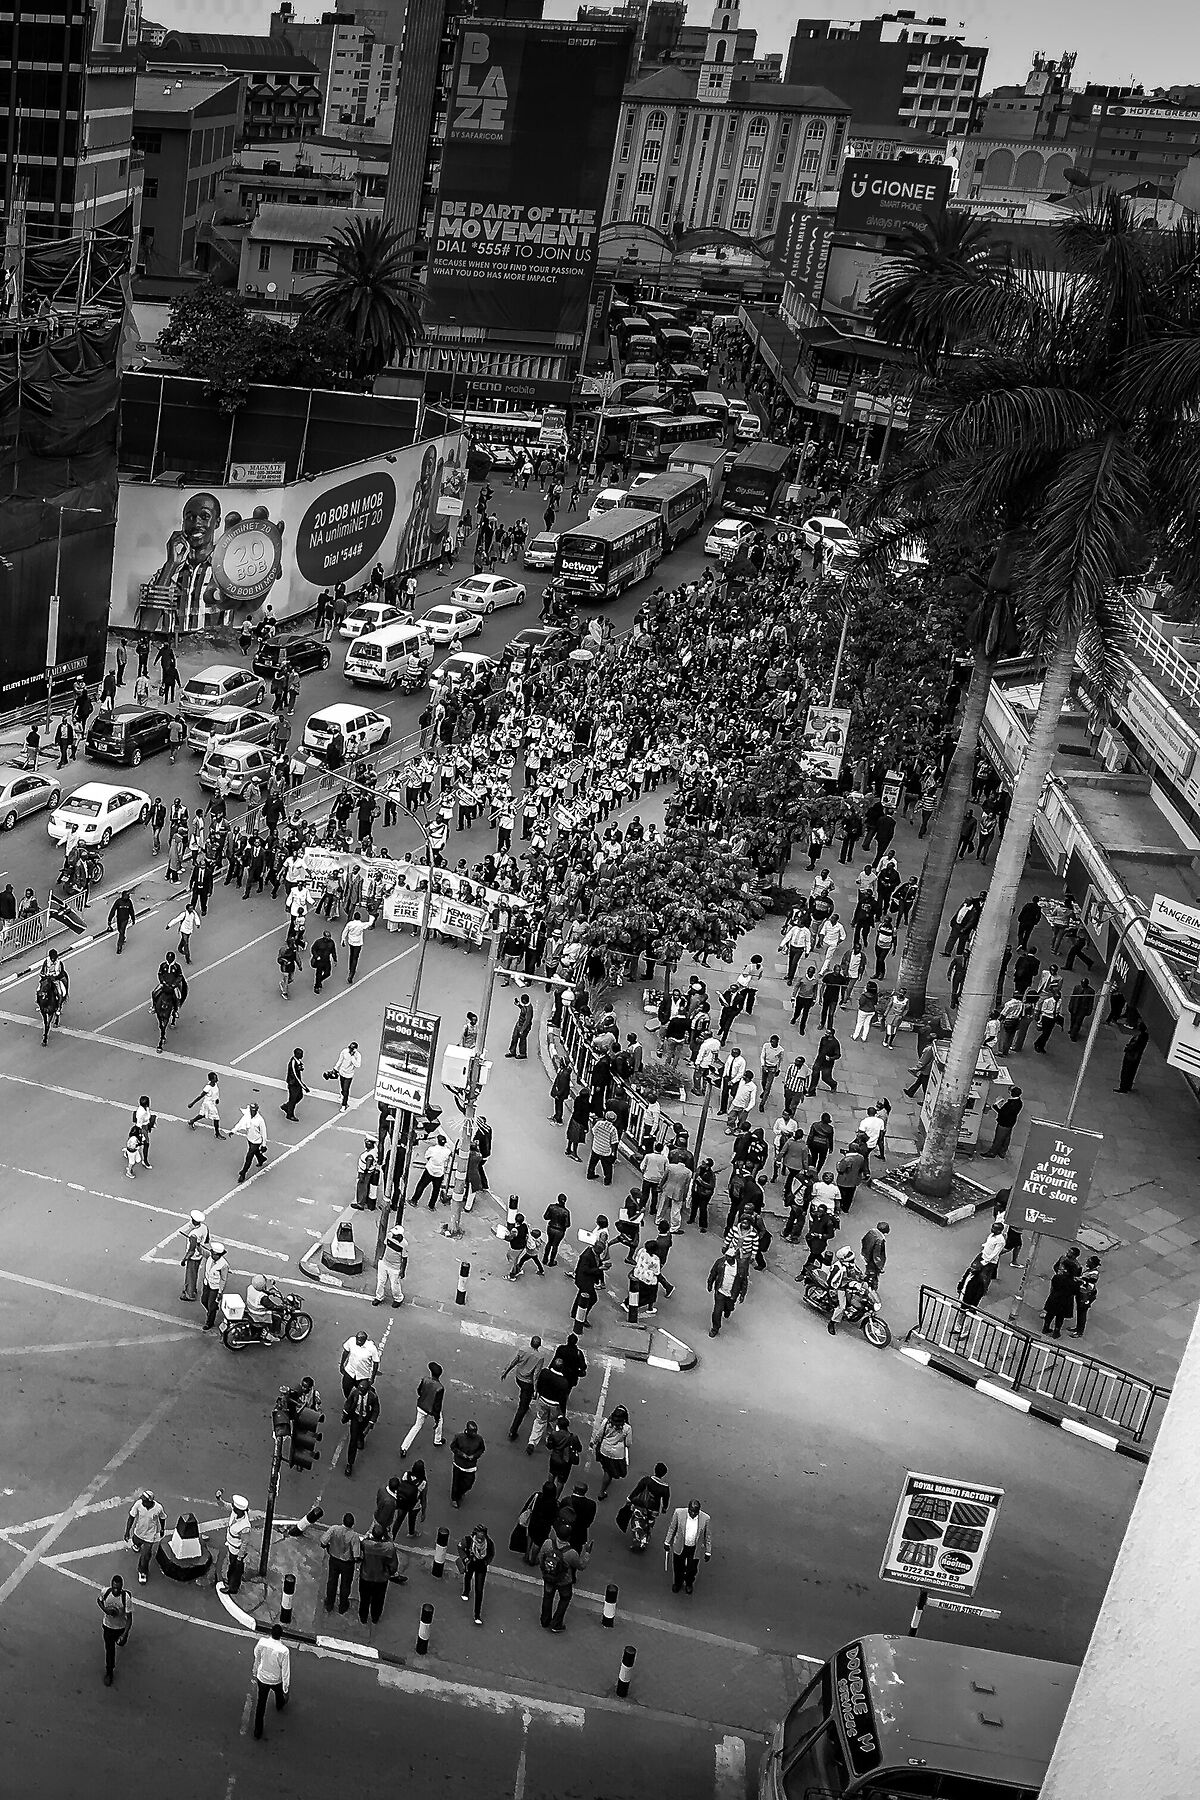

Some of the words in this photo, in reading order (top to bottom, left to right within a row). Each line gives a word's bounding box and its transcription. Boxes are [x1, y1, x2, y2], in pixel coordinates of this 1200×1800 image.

[1130, 107, 1161, 116] HOTEL
[1165, 109, 1199, 118] GREEN
[461, 131, 503, 141] SAFARICOM
[871, 180, 936, 200] GIONEE
[441, 200, 467, 217] BE
[469, 202, 525, 220] PART
[527, 206, 554, 222] OF
[558, 208, 597, 225] THE
[438, 217, 597, 247] MOVEMENT
[436, 240, 467, 253] DIAL
[514, 244, 533, 258] TO
[536, 246, 571, 260] JOIN
[575, 249, 592, 262] US
[434, 258, 466, 268] BECAUSE
[468, 260, 490, 269] WHEN
[492, 262, 509, 271] YOU
[509, 263, 527, 272] FIND
[528, 265, 550, 274] YOUR
[812, 231, 835, 299] SAMSUNG
[432, 267, 455, 276] WHAT
[455, 269, 472, 277] YOU
[473, 270, 486, 278] DO
[486, 271, 502, 279] HAS
[503, 272, 526, 281] MORE
[526, 274, 558, 284] IMPACT.
[465, 380, 502, 392] TECNO
[314, 511, 327, 529] 20
[328, 503, 349, 524] BOB
[350, 499, 360, 517] NI
[362, 491, 384, 512] MOB
[260, 523, 272, 534] 20
[309, 530, 323, 548] NA
[371, 508, 383, 526] 20
[233, 540, 265, 568] 20
[323, 551, 340, 568] Dial
[237, 560, 268, 581] BOB
[561, 559, 599, 575] betway
[226, 583, 237, 593] 20
[237, 588, 254, 597] BOB
[368, 872, 397, 882] NAONS
[393, 908, 419, 917] FIRE
[447, 907, 472, 920] KENYA
[442, 915, 480, 933] JESUS
[386, 1008, 436, 1032] HOTELS
[395, 1025, 412, 1036] 900
[376, 1080, 412, 1098] JUMIA
[1055, 1140, 1074, 1157] Try
[1050, 1153, 1071, 1166] one
[1036, 1161, 1050, 1172] at
[1049, 1166, 1078, 1179] your
[1029, 1169, 1078, 1191] favourite
[1022, 1180, 1048, 1196] KFC
[1048, 1189, 1078, 1204] store
[913, 1481, 934, 1492] ROYAL
[934, 1484, 961, 1497] MABATI
[960, 1489, 995, 1503] FACTORY
[902, 1565, 922, 1575] 0722
[890, 1570, 966, 1590] www.royalmabati.com
[857, 1733, 876, 1752] M
